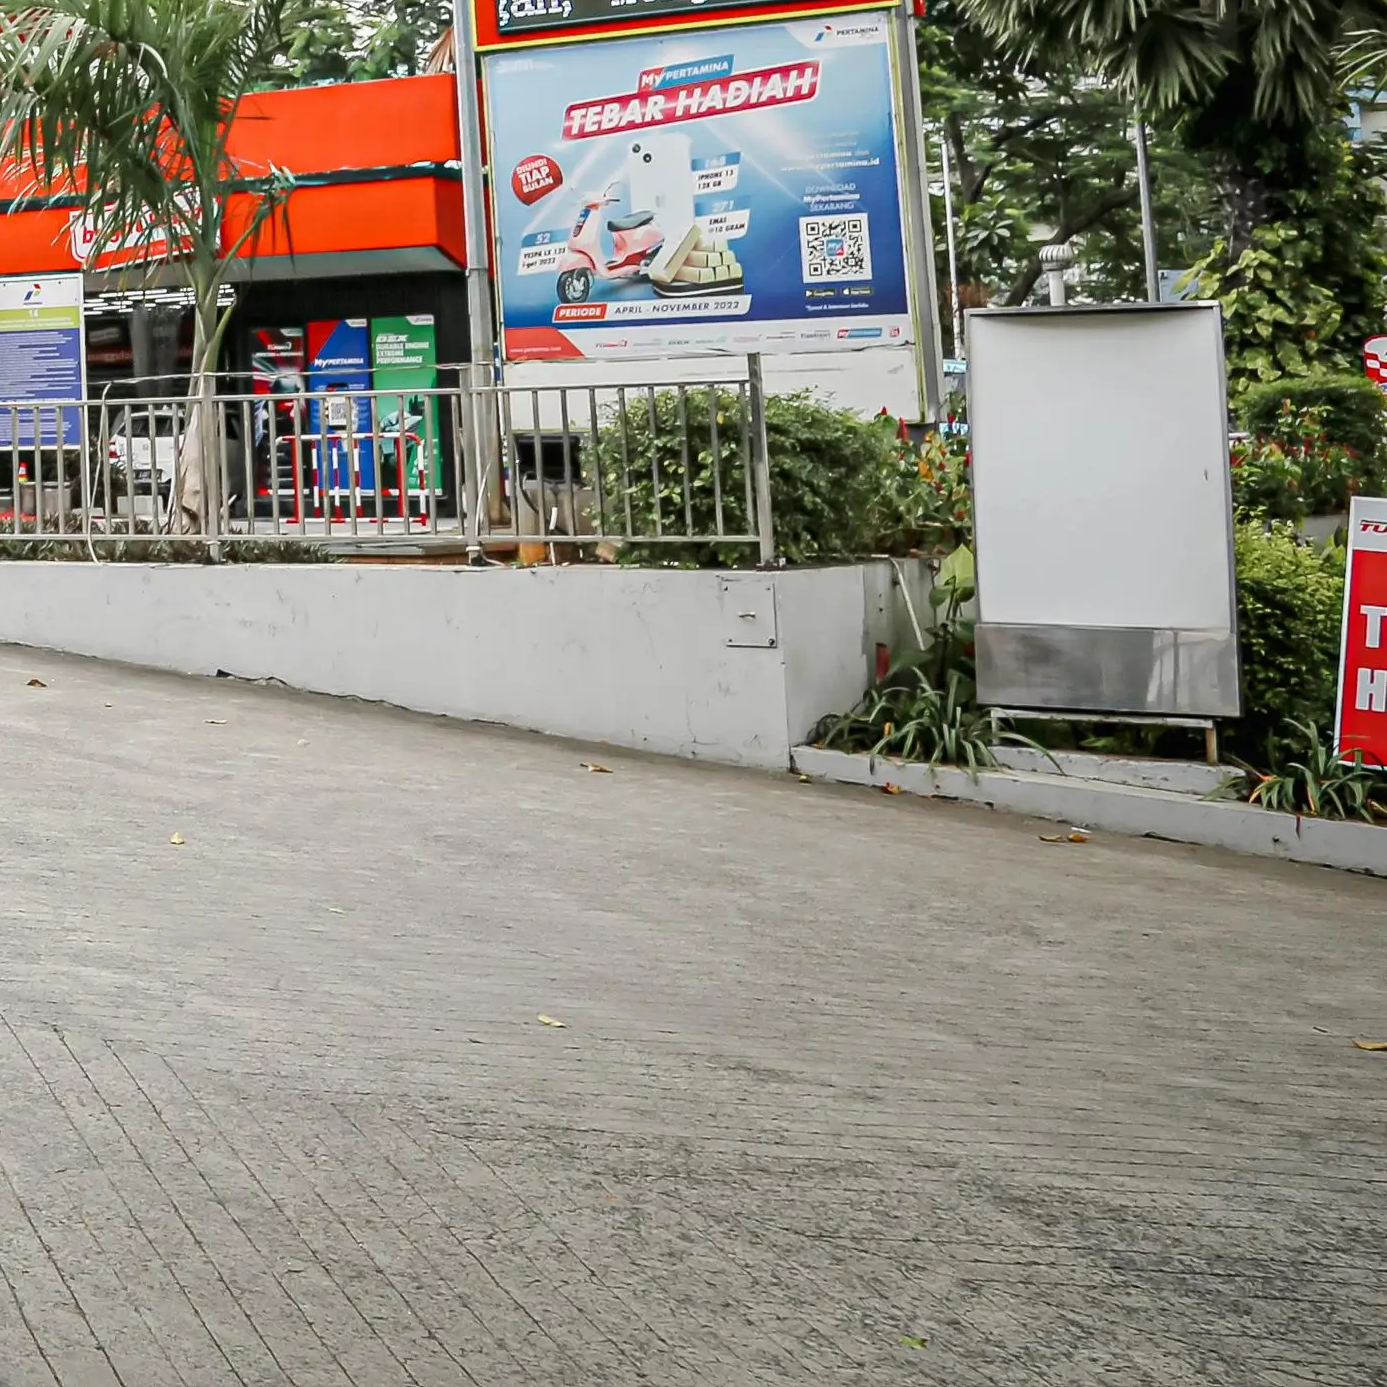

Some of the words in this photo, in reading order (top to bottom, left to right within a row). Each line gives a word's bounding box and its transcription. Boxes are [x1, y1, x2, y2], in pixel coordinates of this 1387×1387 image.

[569, 94, 667, 137] TEBAR
[675, 67, 814, 117] HADIAH
[518, 166, 551, 185] TIAP
[559, 306, 602, 318] PERIODE
[615, 305, 643, 314] APRIL
[652, 302, 711, 313] NOVEMBER
[713, 300, 740, 310] 2022
